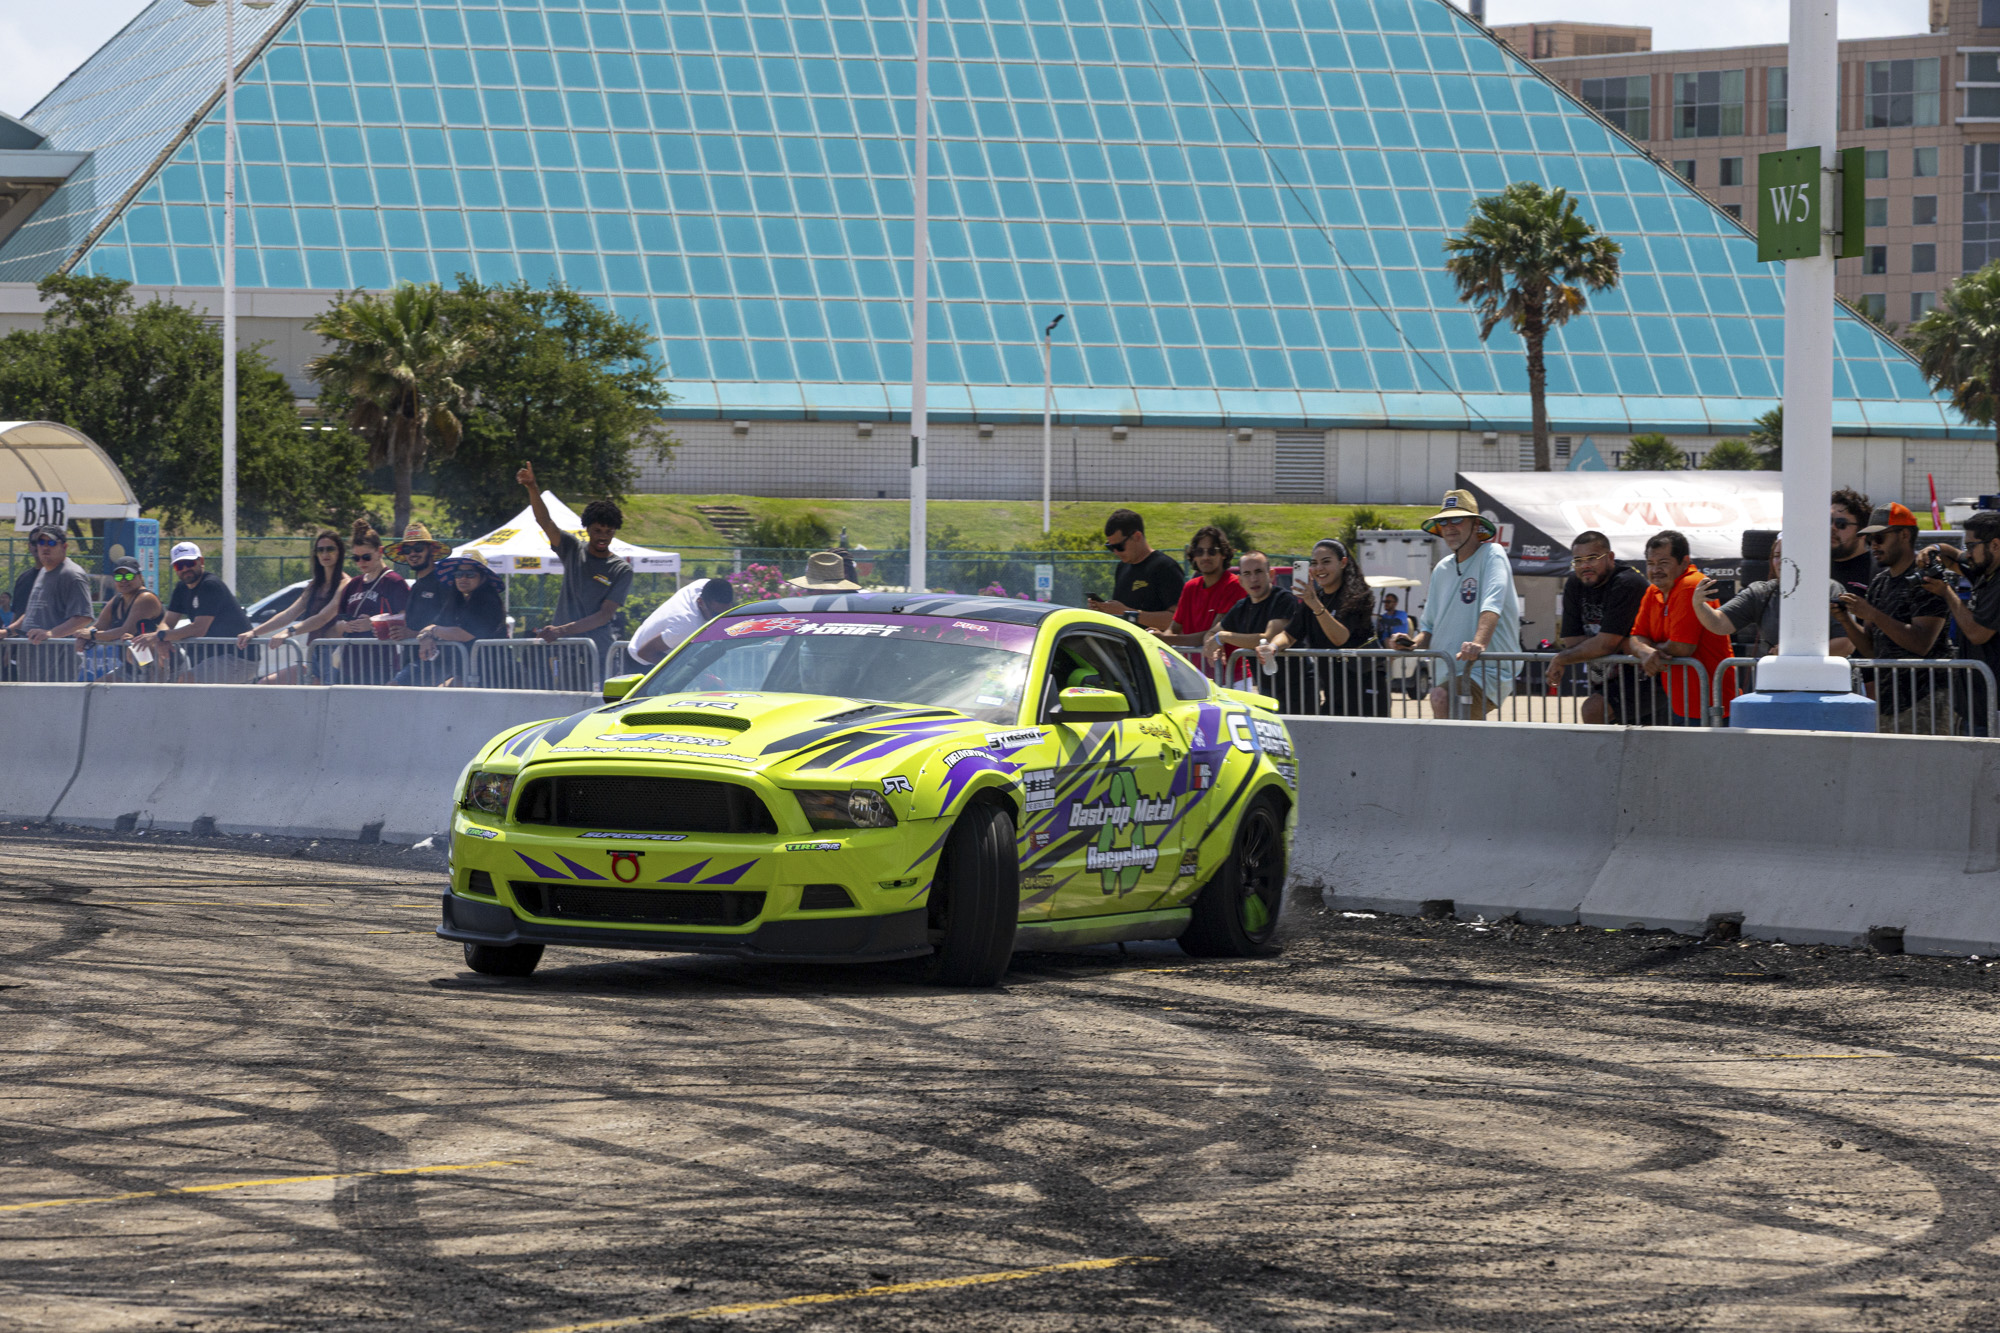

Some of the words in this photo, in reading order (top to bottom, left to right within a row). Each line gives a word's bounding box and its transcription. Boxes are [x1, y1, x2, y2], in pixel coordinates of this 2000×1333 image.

[1769, 182, 1810, 225] W5
[22, 496, 65, 527] BAR
[1522, 545, 1551, 557] TREMEC
[1703, 567, 1734, 576] SPEED
[1069, 799, 1131, 832] Bastrop
[1134, 794, 1176, 823] Metal
[583, 831, 687, 841] SUPERSPEED
[1086, 843, 1158, 872] Recycling
